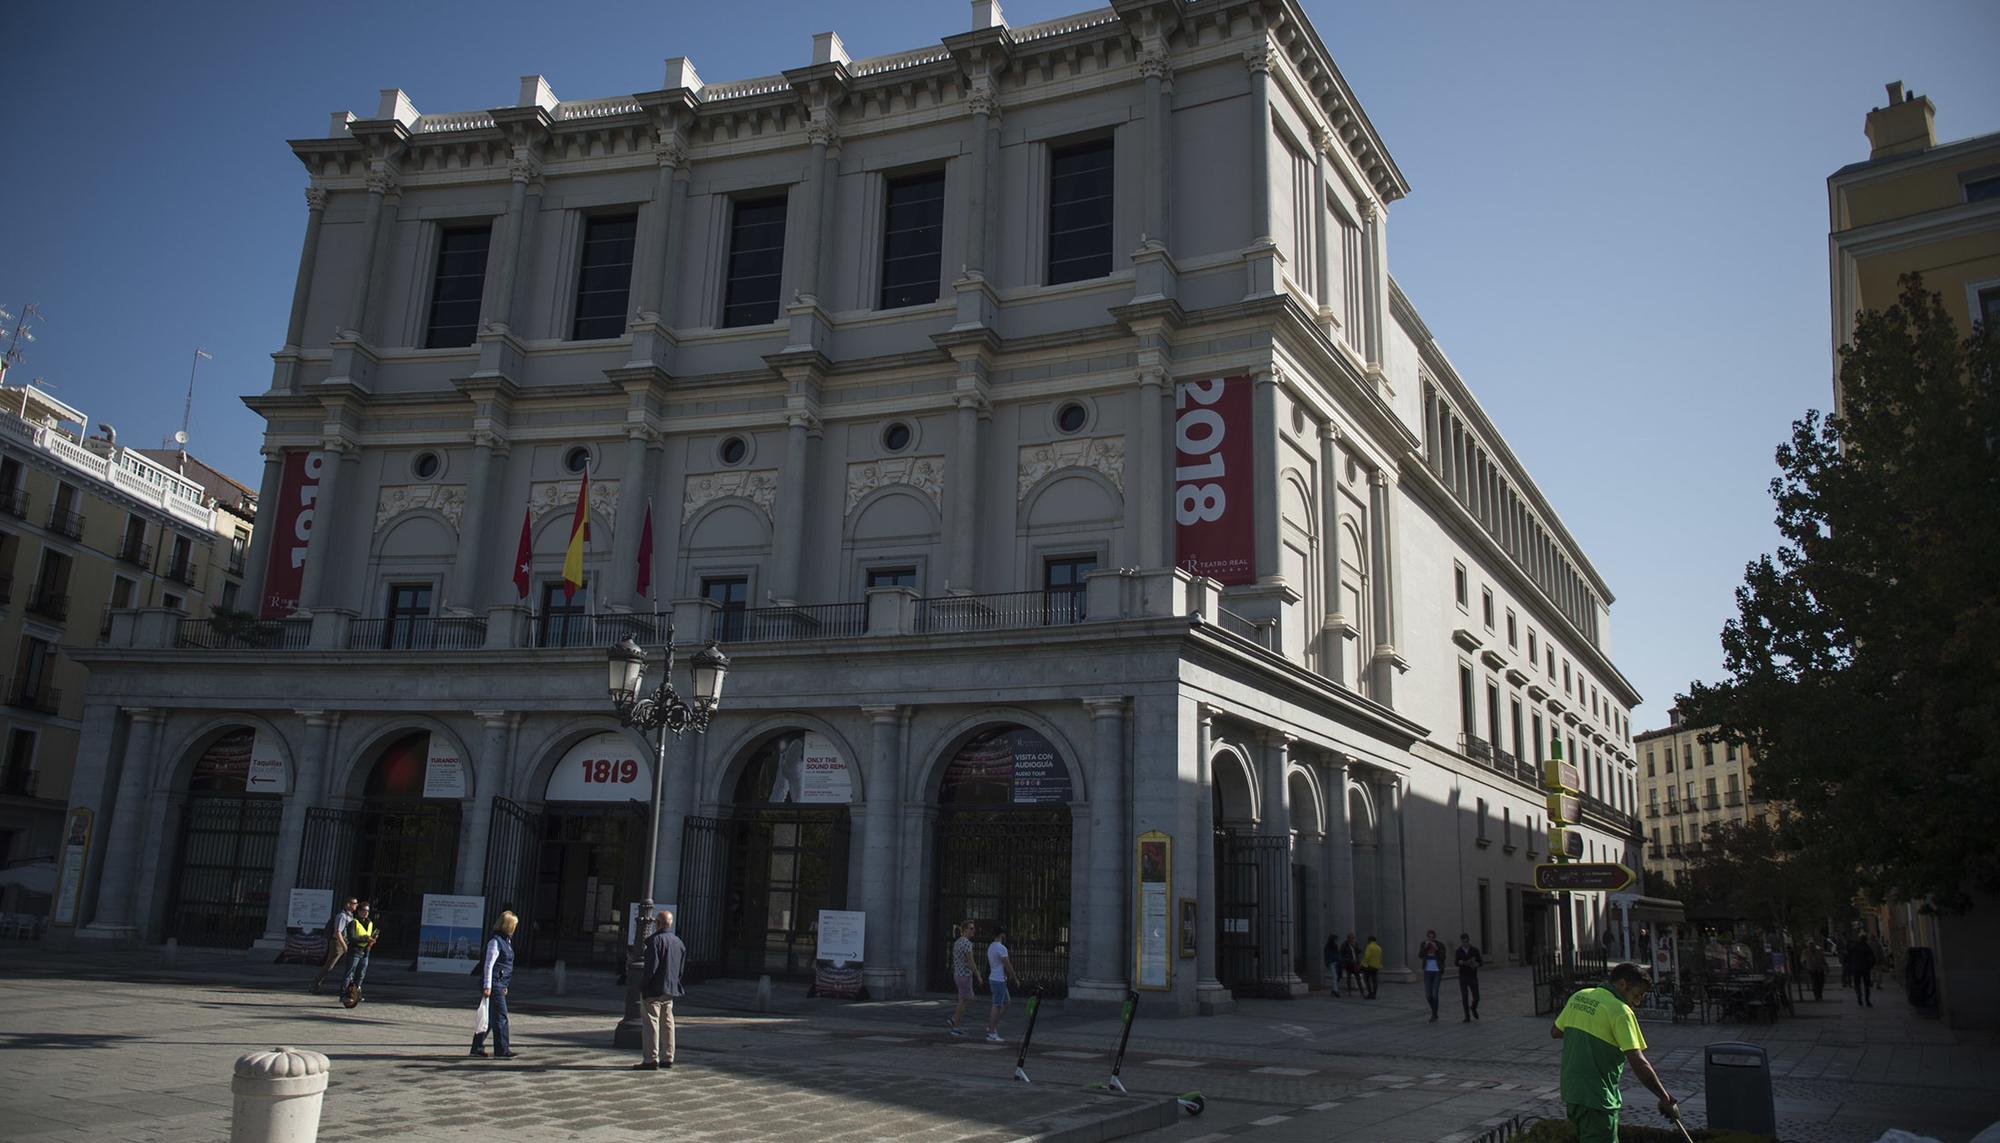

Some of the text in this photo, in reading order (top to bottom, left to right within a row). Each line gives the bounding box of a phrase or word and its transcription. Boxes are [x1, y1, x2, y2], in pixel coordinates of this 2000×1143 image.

[1176, 378, 1226, 526] 2018
[1200, 560, 1228, 568] TEATRO
[1015, 753, 1037, 761] VISITA
[253, 759, 282, 768] Taquillas
[1015, 760, 1054, 769] AUDIOGUÍA
[582, 759, 639, 784] 1819
